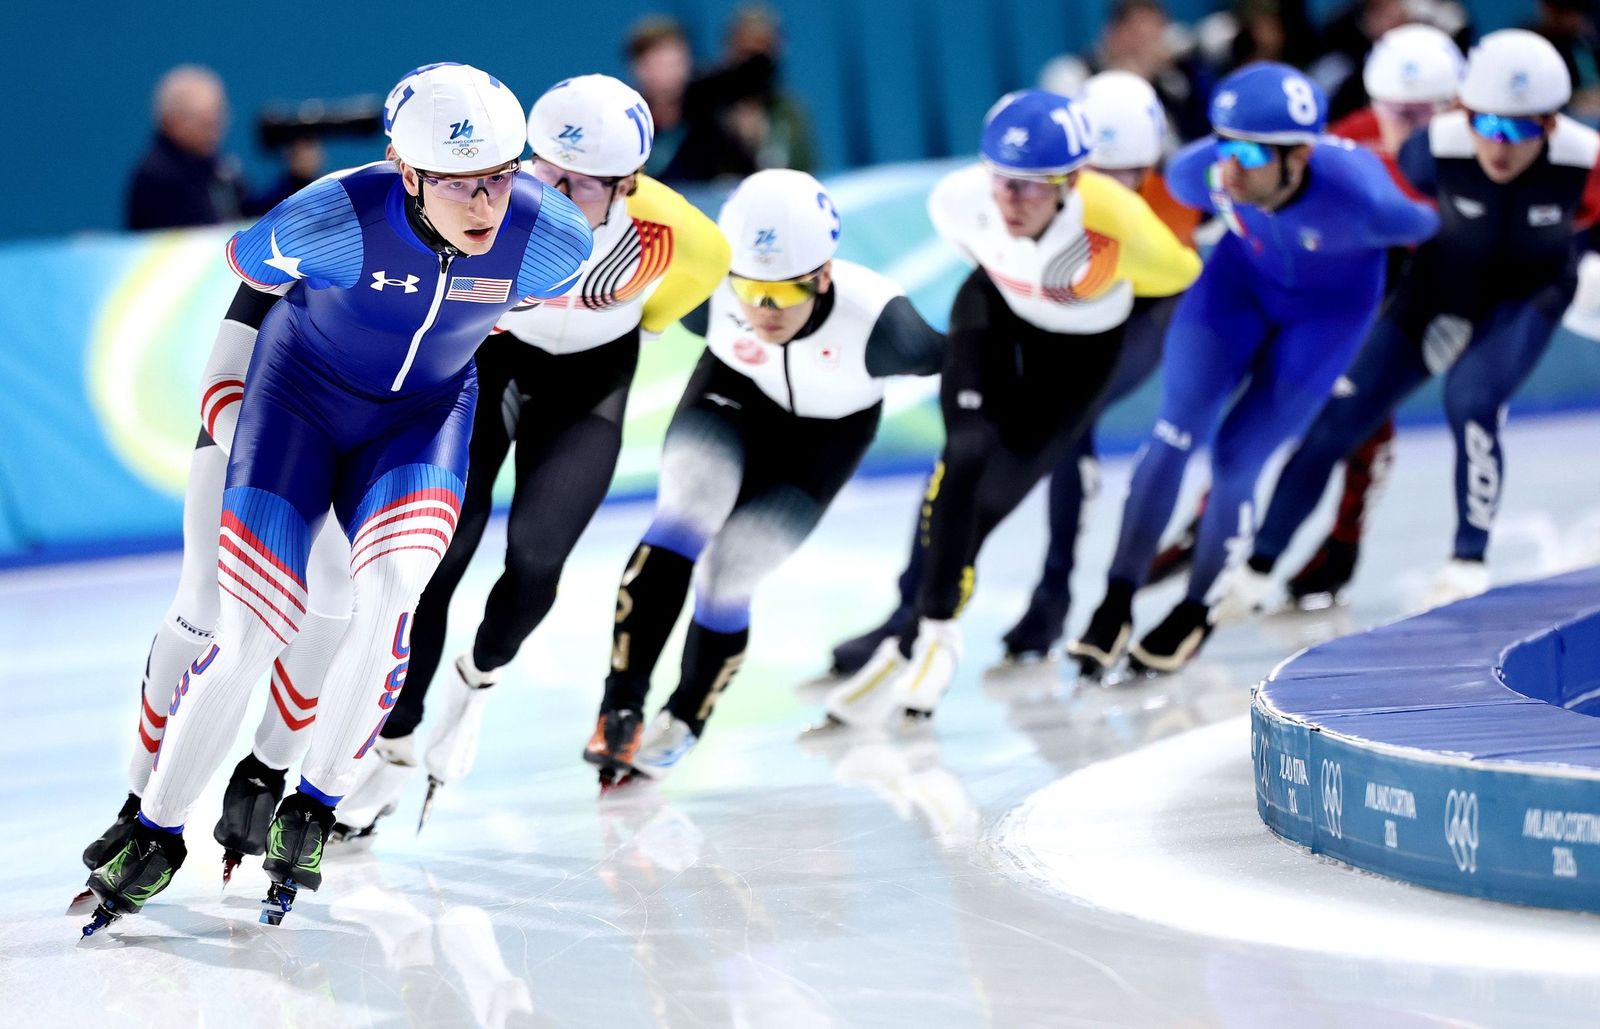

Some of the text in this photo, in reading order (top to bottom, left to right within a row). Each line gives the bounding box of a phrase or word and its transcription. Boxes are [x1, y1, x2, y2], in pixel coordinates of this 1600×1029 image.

[1281, 75, 1318, 126] 8
[1049, 102, 1098, 157] 10
[816, 192, 842, 241] 3
[1465, 420, 1499, 531] KOR
[1521, 807, 1564, 841] MILANO
